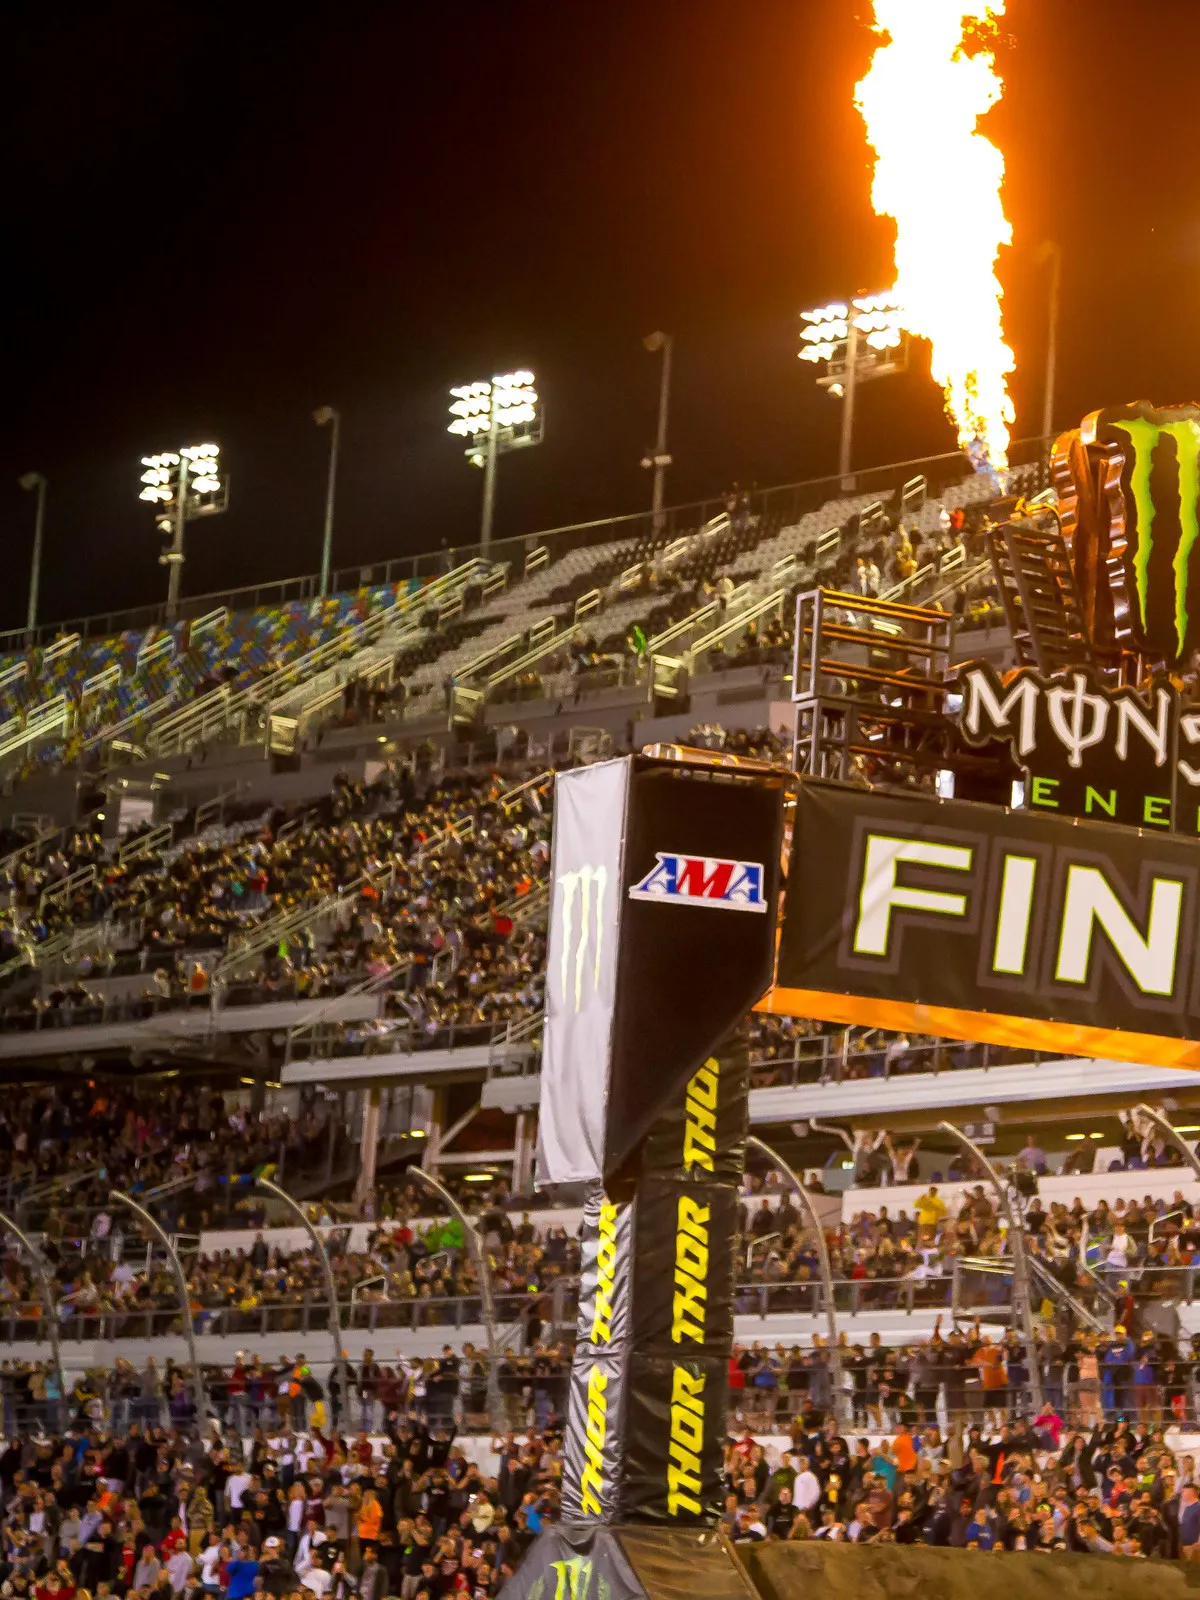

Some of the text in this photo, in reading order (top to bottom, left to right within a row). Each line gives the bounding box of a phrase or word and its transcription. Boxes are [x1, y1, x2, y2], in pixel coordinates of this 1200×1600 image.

[629, 853, 767, 912] AMA
[671, 1195, 711, 1344] THOR
[581, 1365, 608, 1515] THOR
[667, 1366, 706, 1515] THOR
